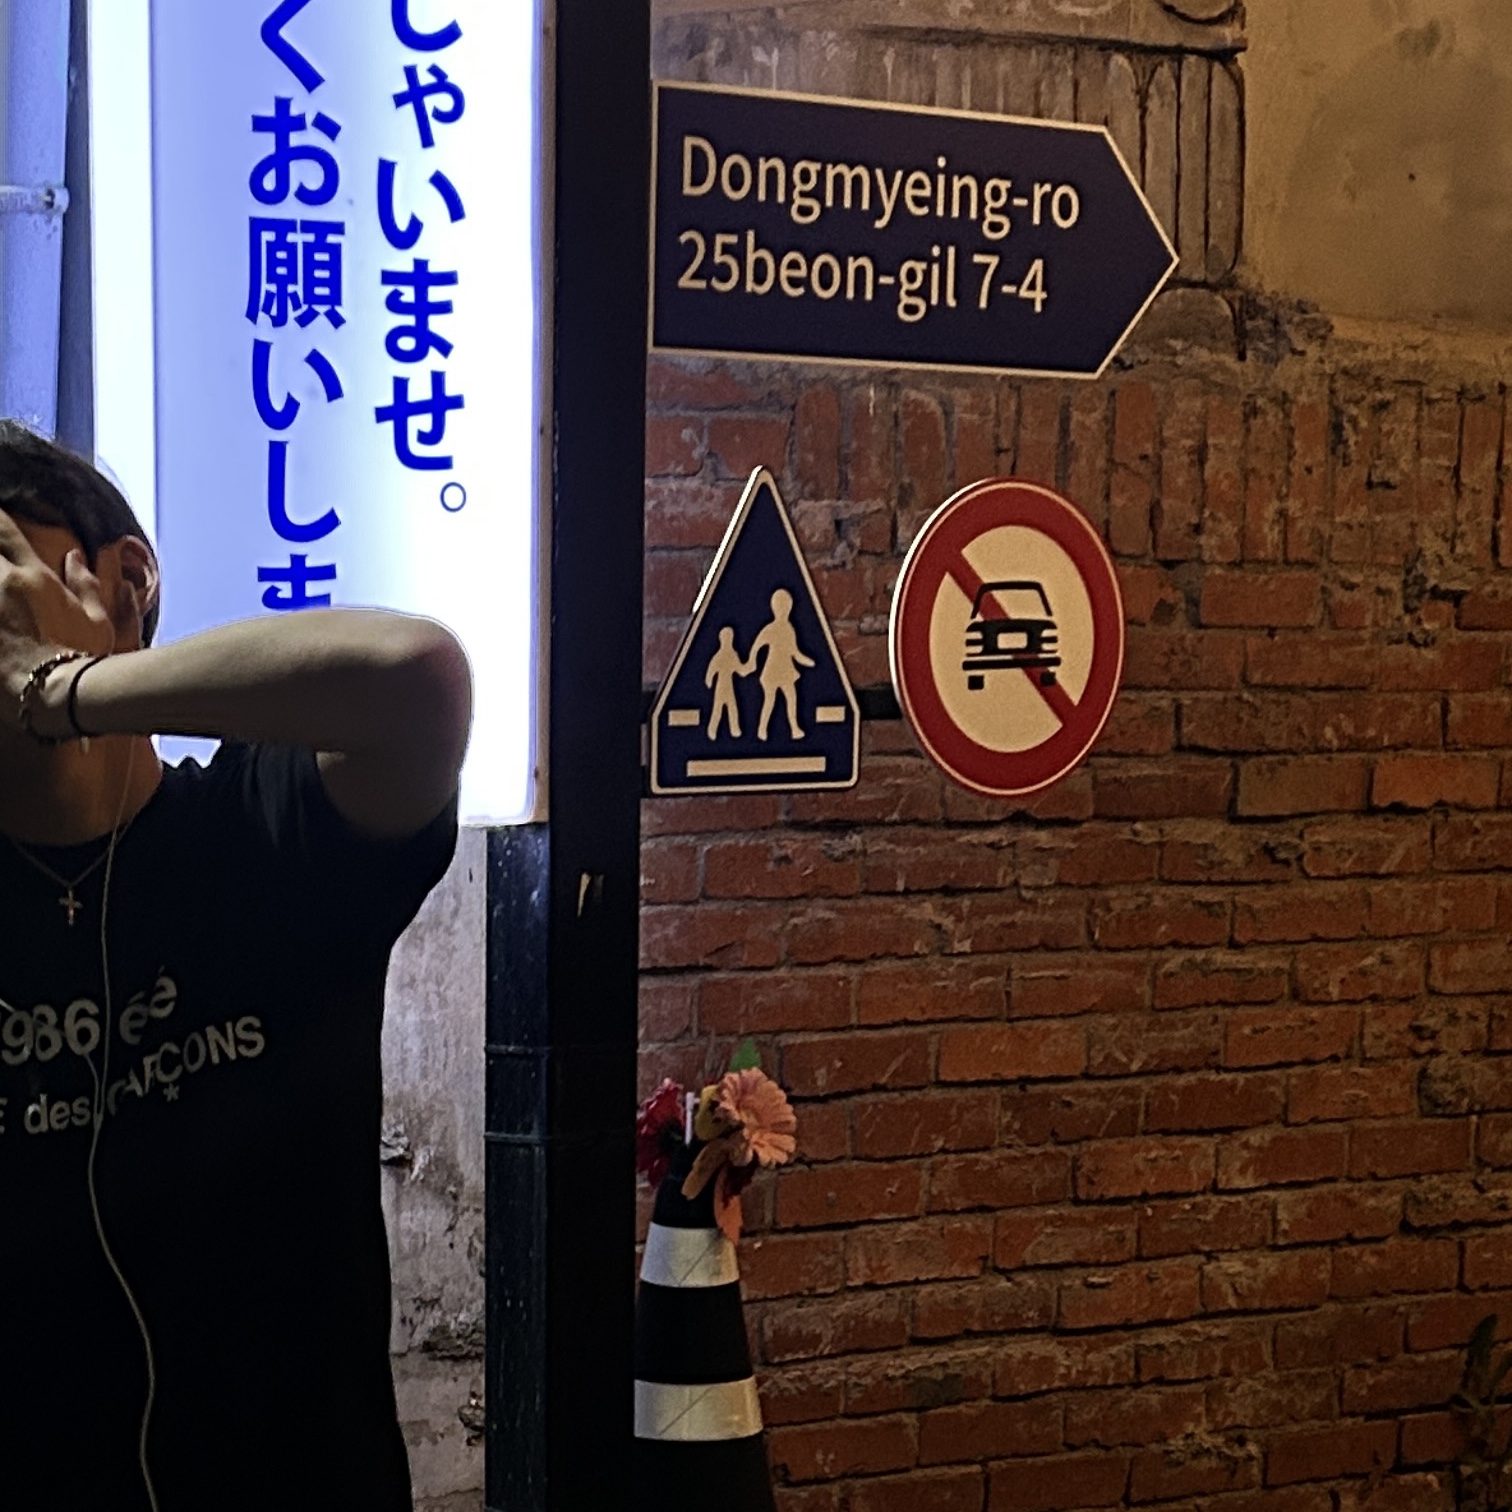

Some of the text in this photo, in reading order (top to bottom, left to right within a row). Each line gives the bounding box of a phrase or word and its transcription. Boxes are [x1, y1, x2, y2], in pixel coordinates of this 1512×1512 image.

[681, 136, 1080, 240] Dongmyeing-ro
[677, 229, 1048, 322] 25beon-gil 7-4
[24, 1093, 90, 1134] des
